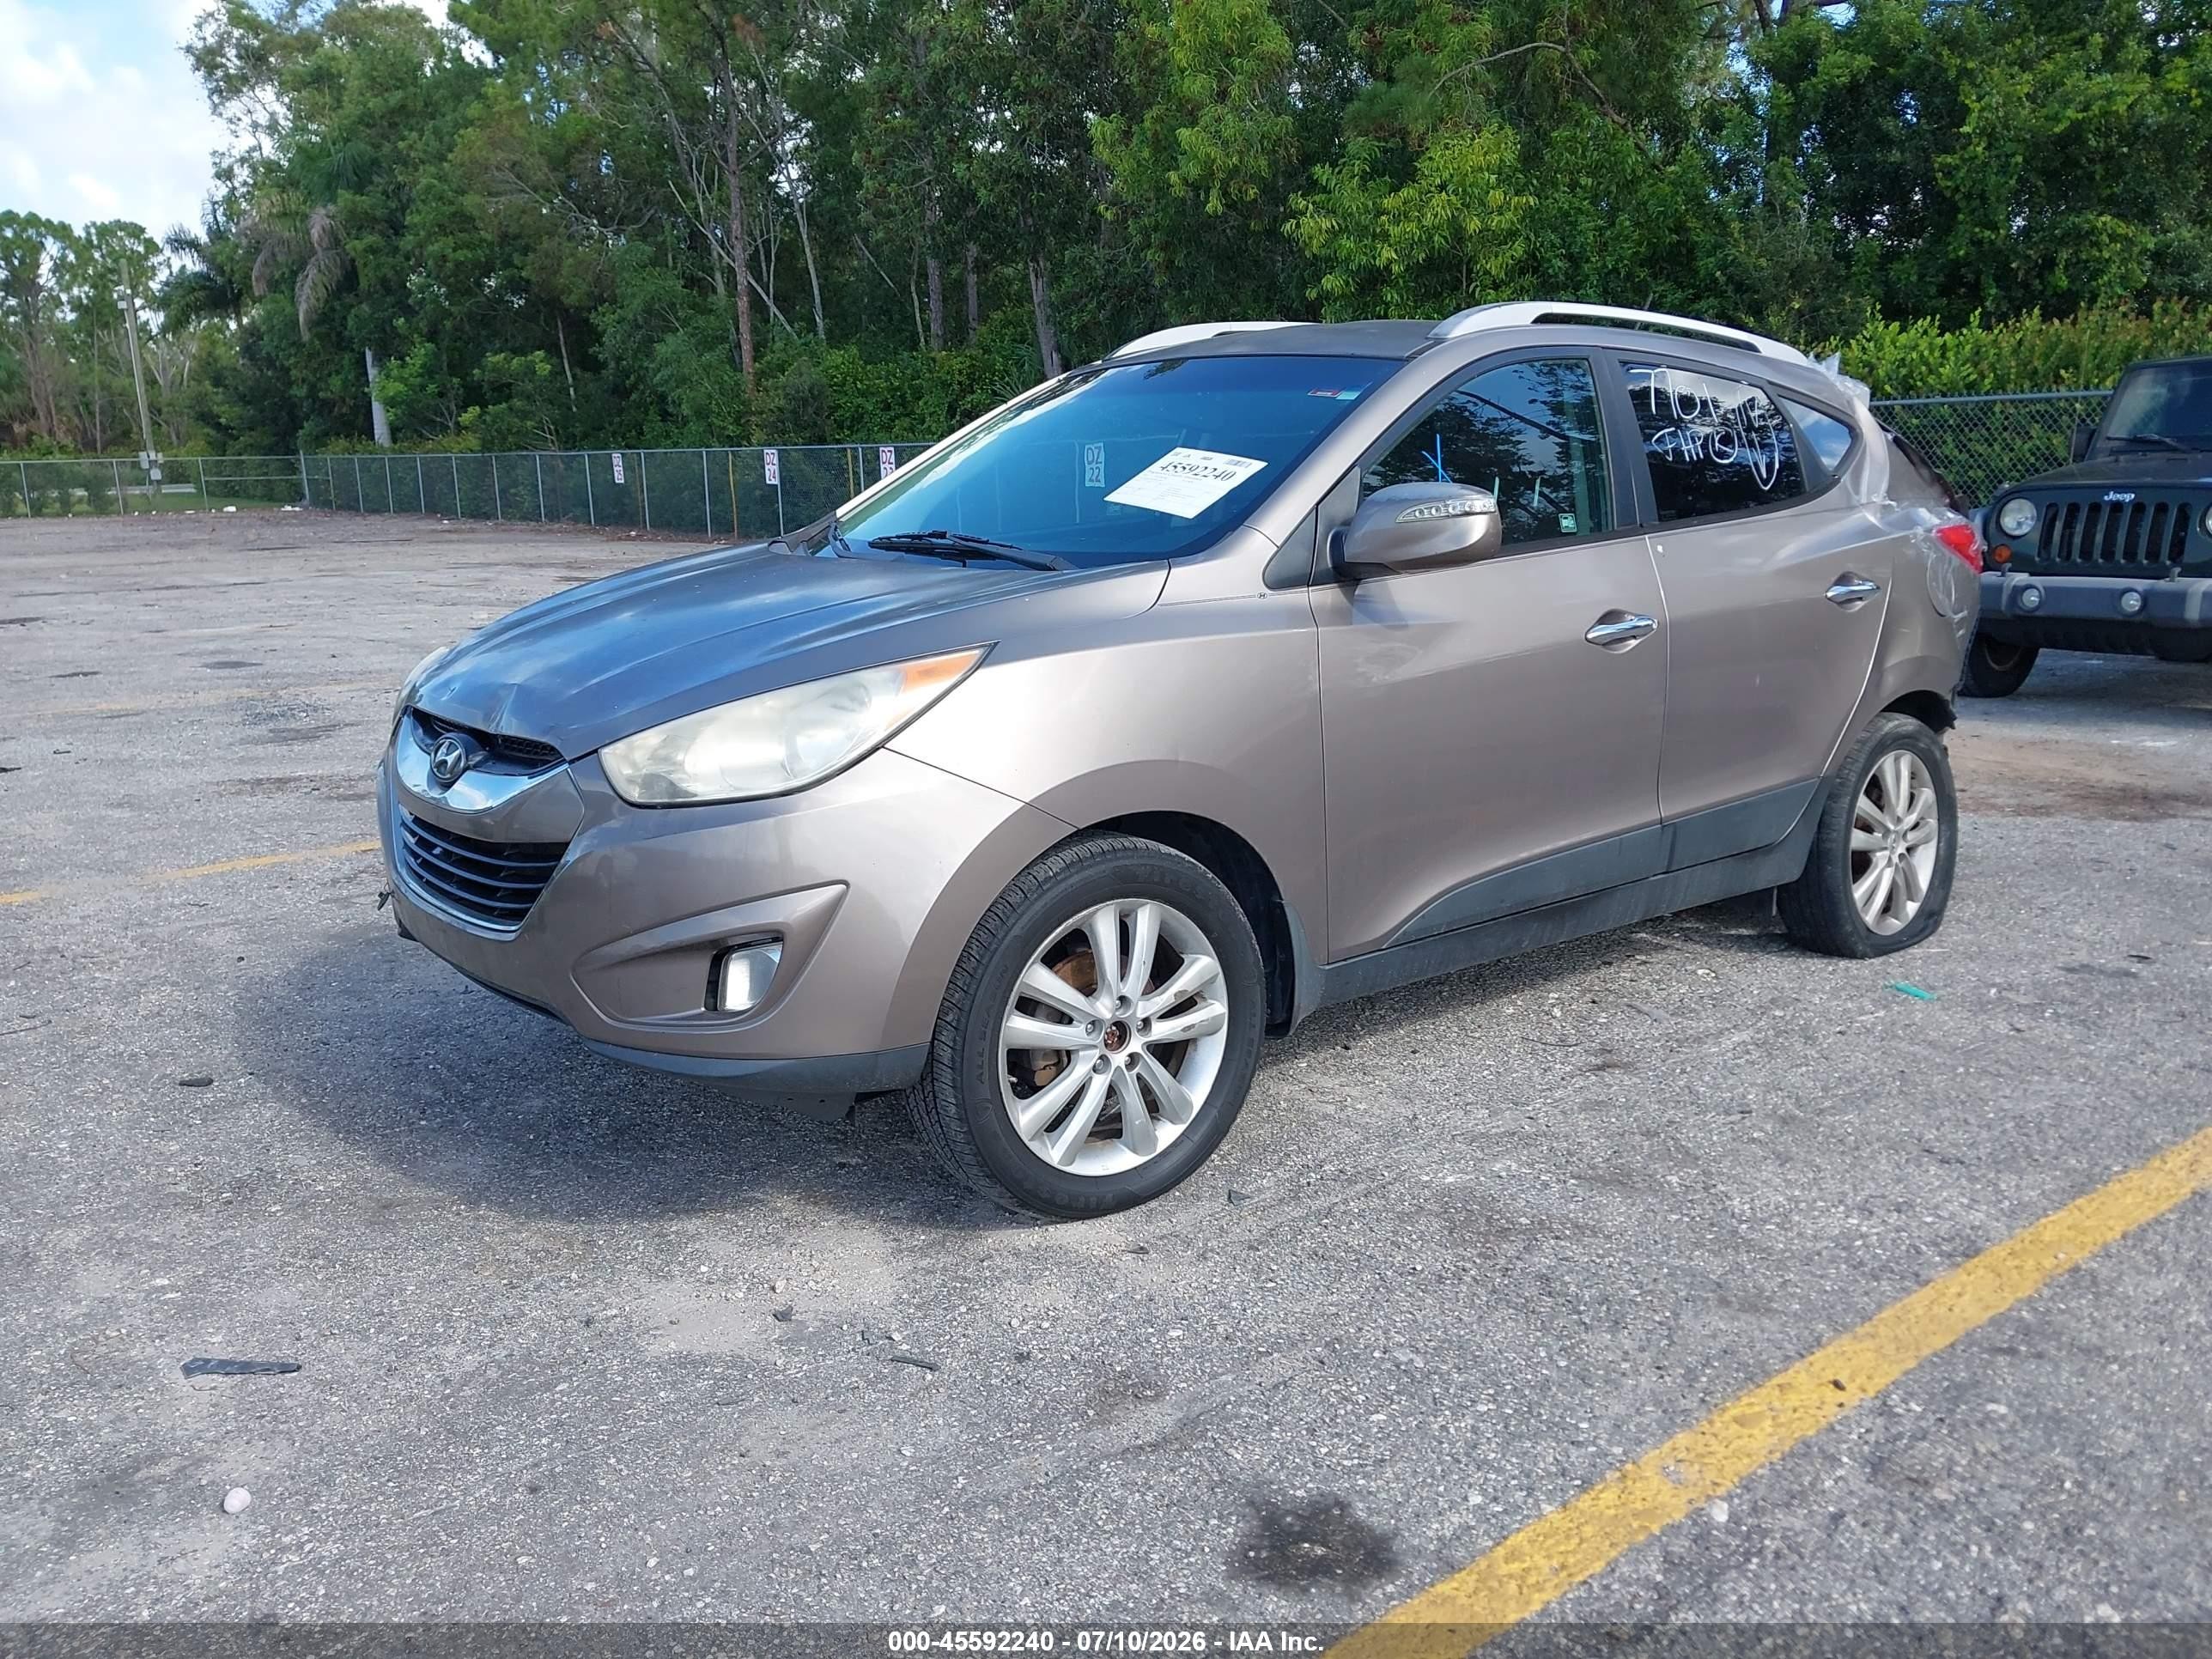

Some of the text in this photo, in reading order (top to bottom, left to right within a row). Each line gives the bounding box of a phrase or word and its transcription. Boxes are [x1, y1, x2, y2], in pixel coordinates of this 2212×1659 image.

[613, 455, 623, 467] DZ
[765, 452, 776, 466] DZ
[881, 449, 894, 465] DZ
[1086, 447, 1103, 465] DZ
[616, 469, 623, 482] 25
[768, 468, 777, 483] 24
[1089, 465, 1102, 483] 22
[1159, 461, 1236, 482] 45592240
[2103, 491, 2136, 502] Jeep
